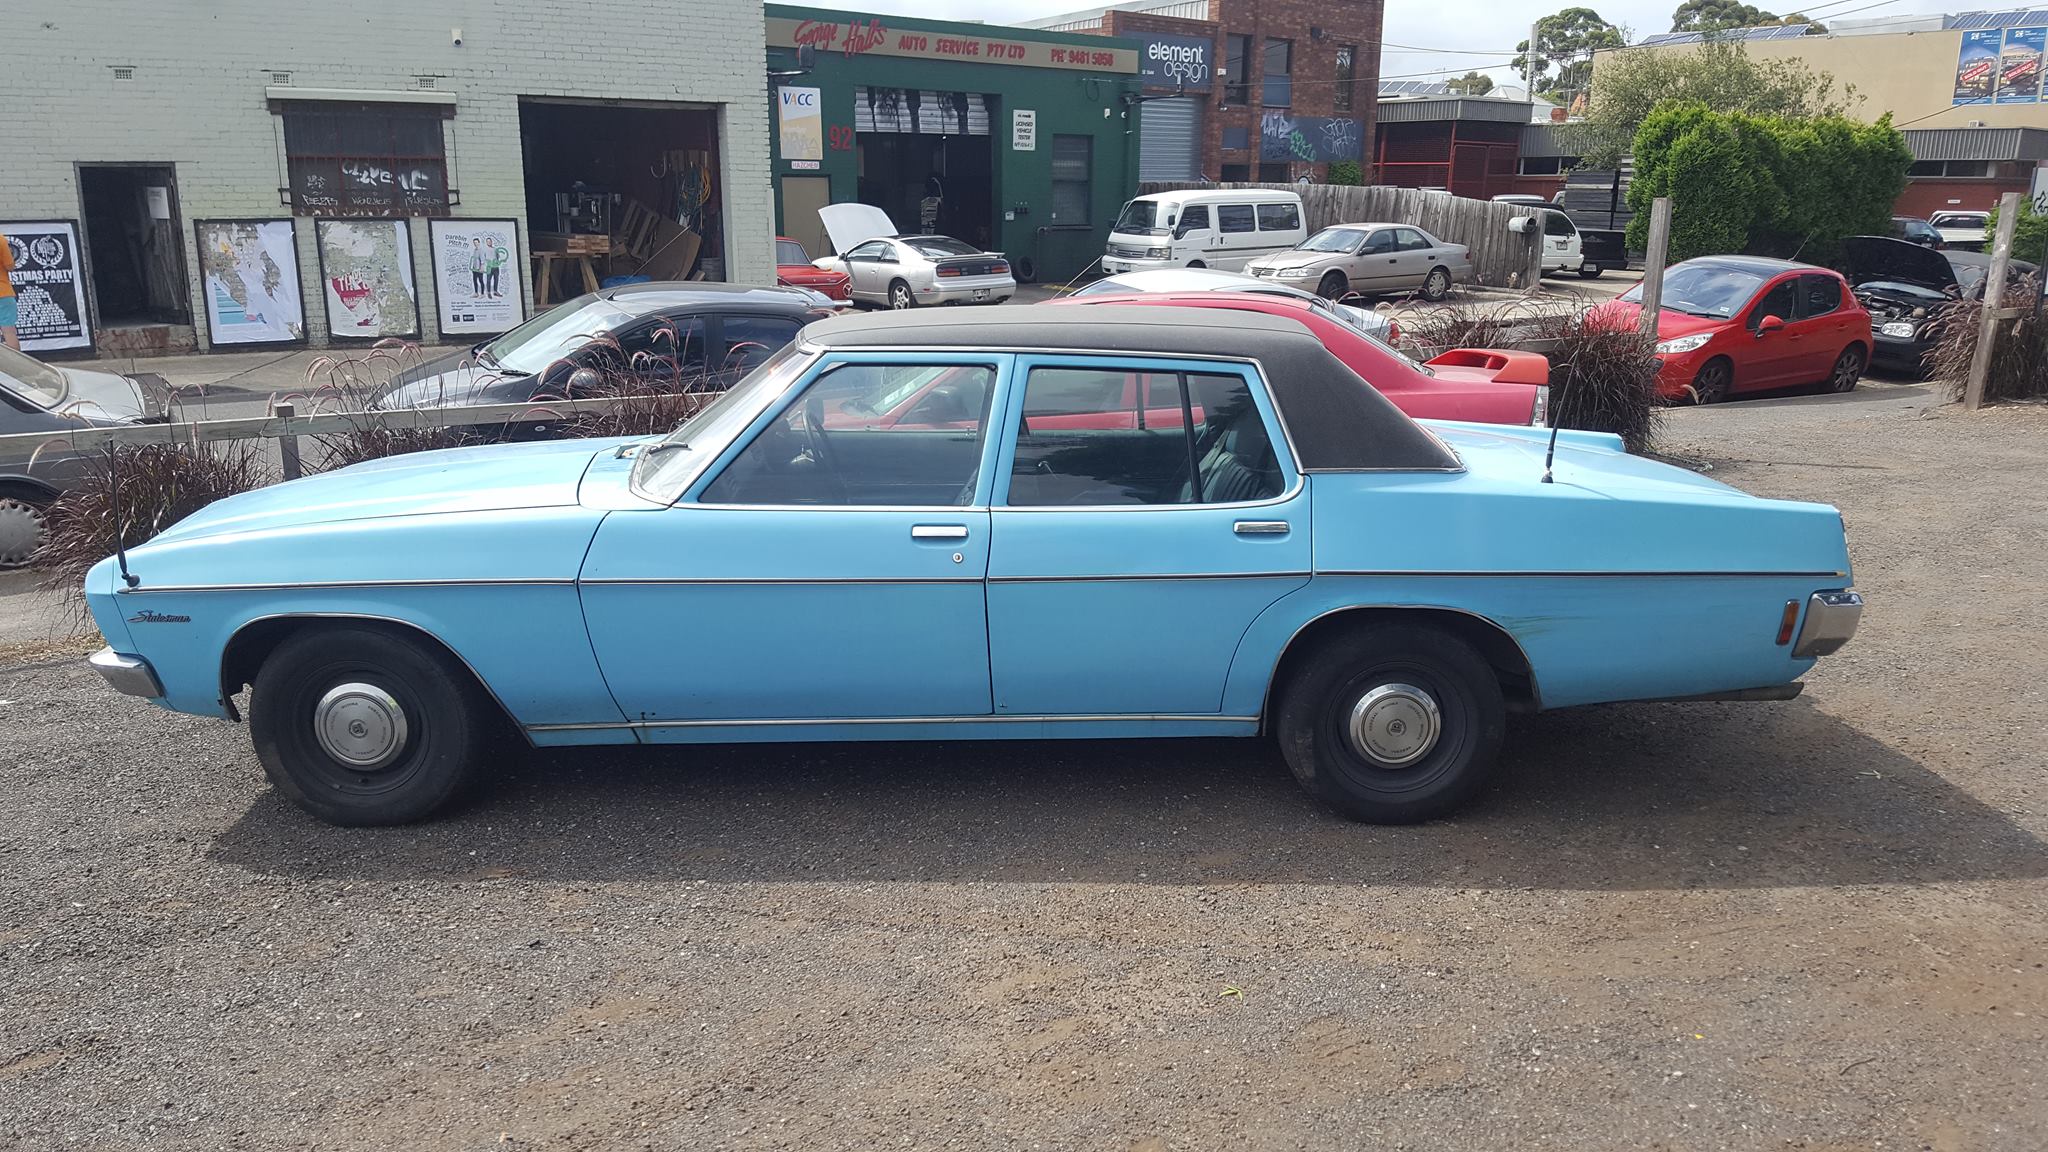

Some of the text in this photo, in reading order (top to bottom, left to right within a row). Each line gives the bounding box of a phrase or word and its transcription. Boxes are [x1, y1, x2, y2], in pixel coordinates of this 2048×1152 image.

[898, 35, 928, 51] AUTO
[935, 38, 979, 56] SERVICE
[987, 43, 1005, 58] PTY
[1007, 45, 1026, 59] LTD
[1148, 42, 1204, 63] element
[1164, 60, 1208, 83] design
[783, 92, 814, 106] VACC
[829, 123, 852, 151] 92
[8, 269, 73, 281] ISTMAS PARTY
[128, 609, 191, 623] Statesman
